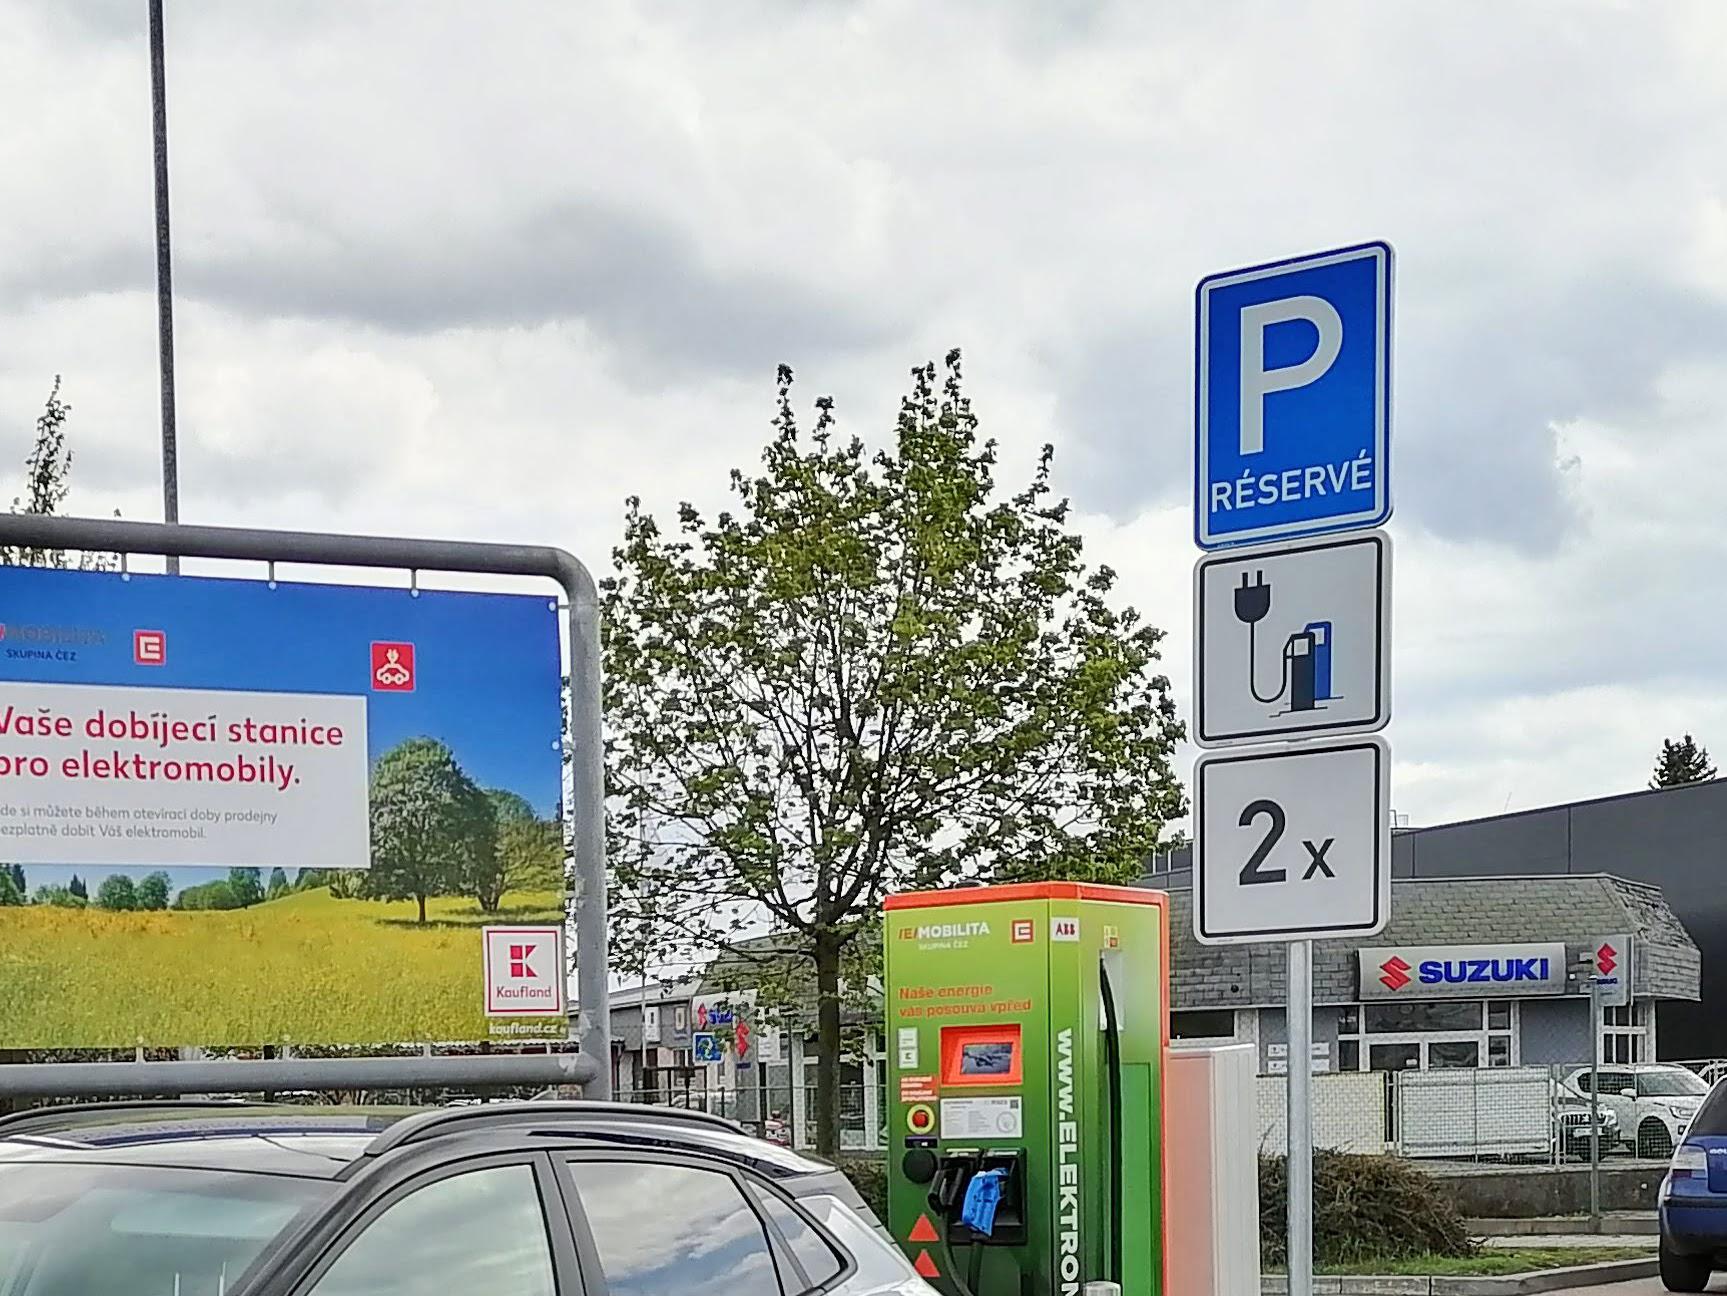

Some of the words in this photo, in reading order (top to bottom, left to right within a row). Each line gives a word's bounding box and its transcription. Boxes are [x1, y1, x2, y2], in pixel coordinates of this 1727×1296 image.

[1239, 294, 1345, 457] P
[1210, 452, 1373, 513] RÉSERVÉ
[6, 648, 52, 660] SKUPINA
[85, 709, 217, 748] dobíjecí
[228, 717, 344, 746] stanice
[61, 750, 301, 791] elektromobily.
[20, 804, 30, 817] si
[33, 804, 82, 818] můžete
[85, 806, 130, 819] během
[190, 809, 221, 823] doby
[224, 810, 278, 825] prodejny
[1238, 798, 1287, 886] 2
[1055, 923, 1075, 936] ABB
[1418, 957, 1550, 984] SUZUKI
[496, 986, 552, 998] Kaufland
[899, 986, 934, 1000] Naše
[938, 985, 993, 998] energie
